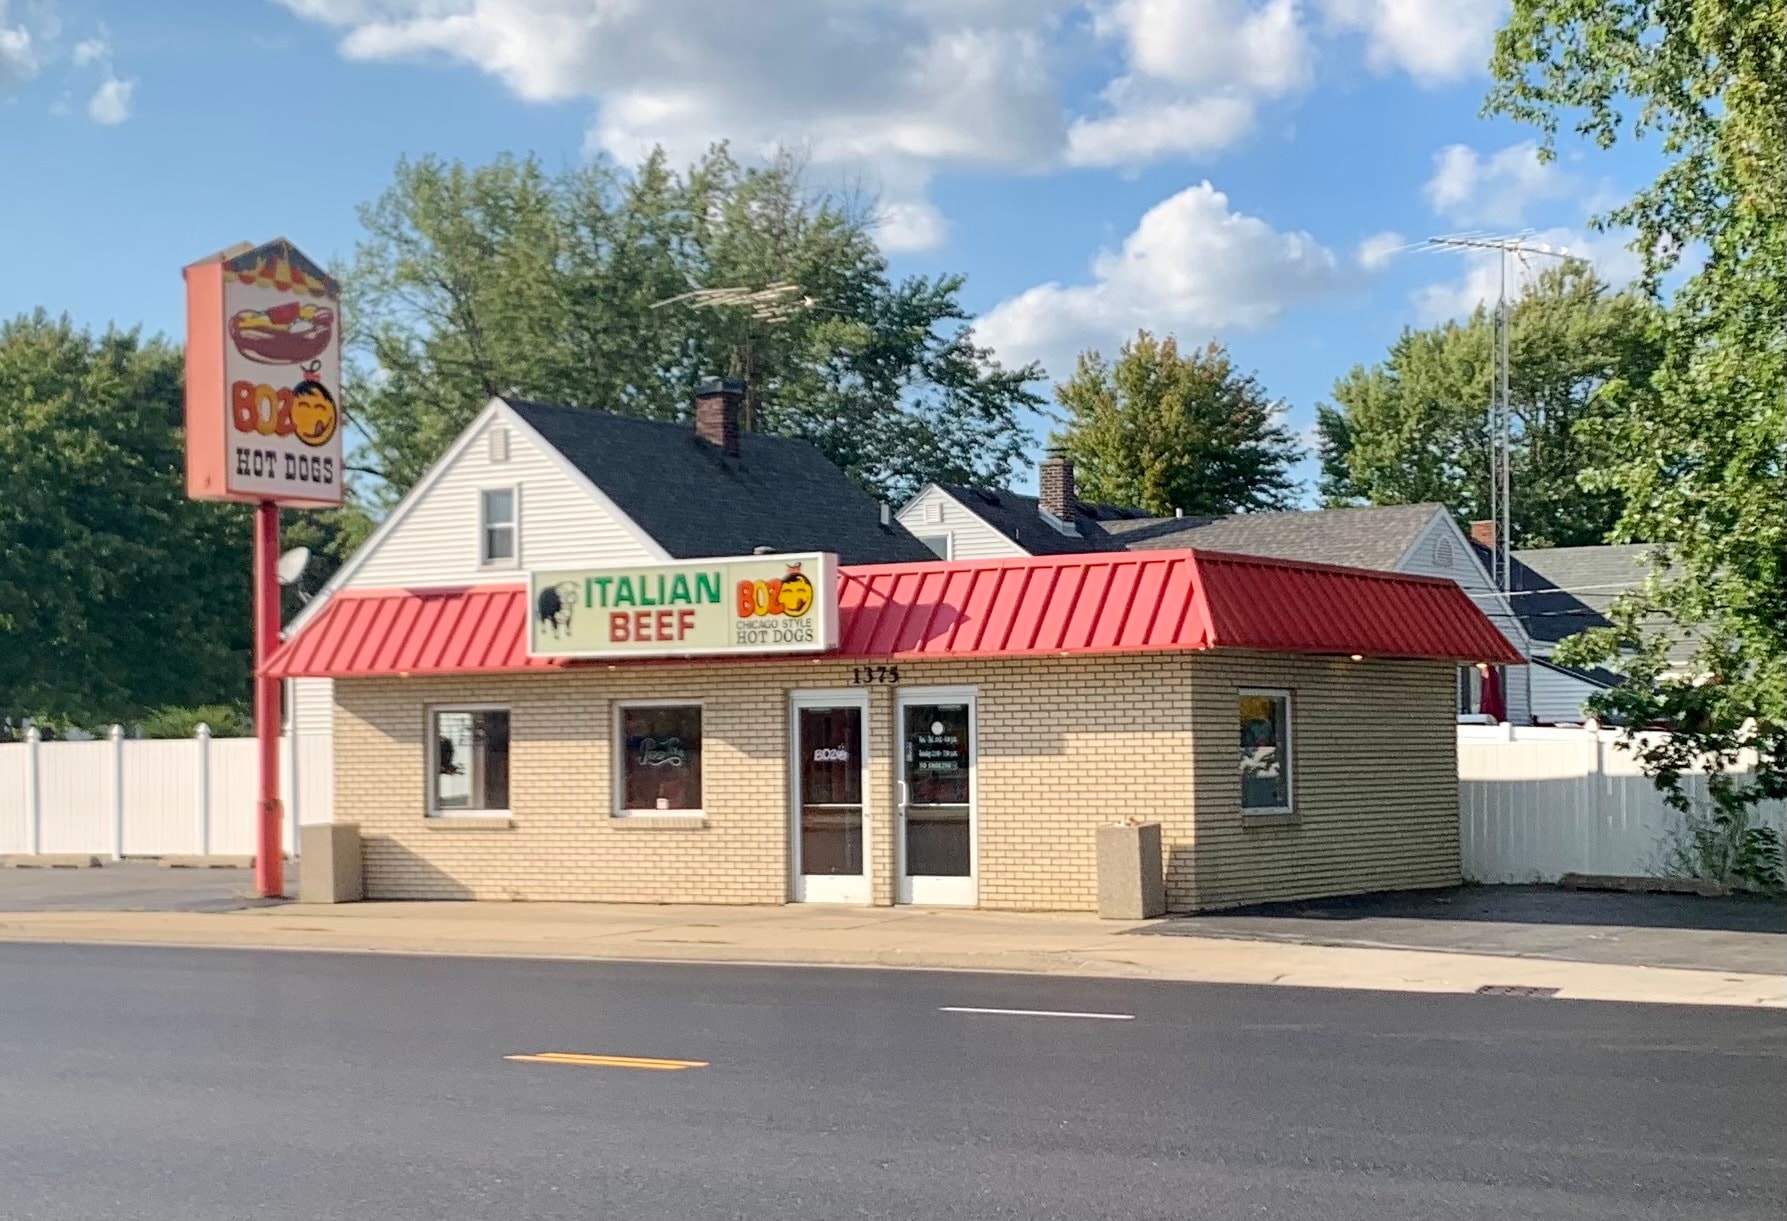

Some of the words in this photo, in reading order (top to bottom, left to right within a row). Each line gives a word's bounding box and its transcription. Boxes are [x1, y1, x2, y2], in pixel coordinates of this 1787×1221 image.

[236, 447, 277, 478] HOT
[284, 451, 333, 484] DOGS
[584, 571, 721, 608] ITALIAN
[609, 608, 695, 642] BEEF
[736, 620, 778, 630] CHICAGO
[782, 618, 812, 629] STYLE
[736, 630, 768, 644] HOT
[773, 628, 813, 643] DOGS
[852, 664, 899, 684] 1375
